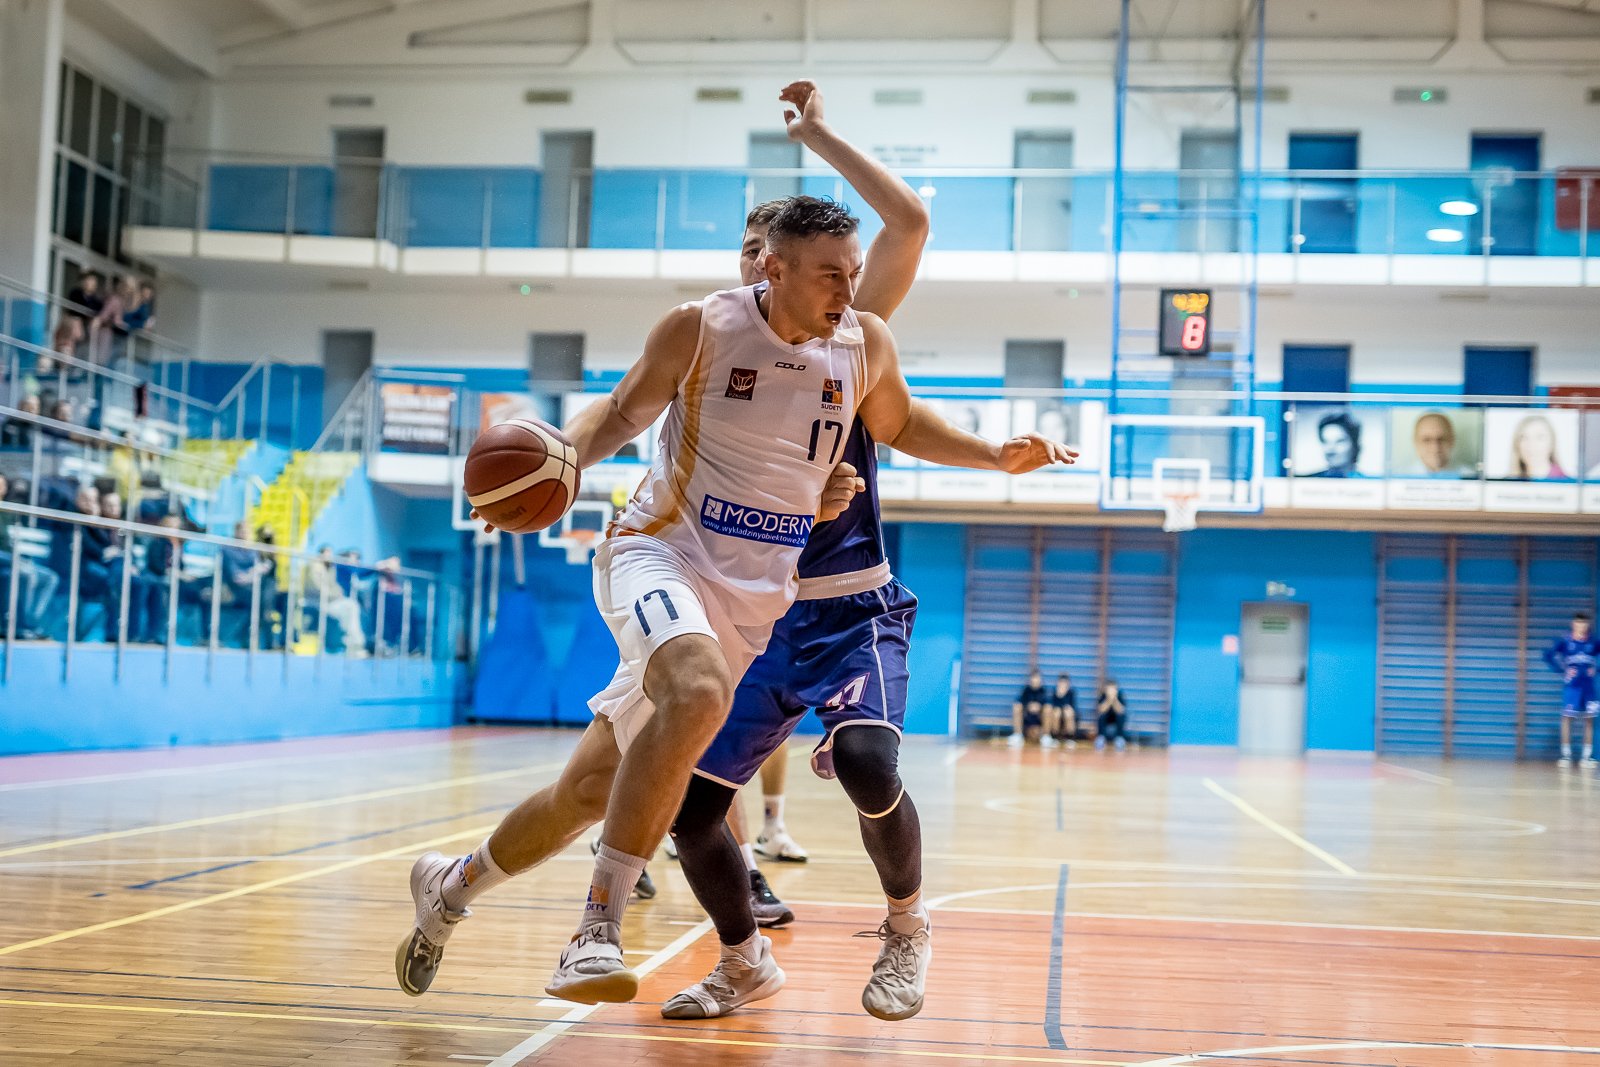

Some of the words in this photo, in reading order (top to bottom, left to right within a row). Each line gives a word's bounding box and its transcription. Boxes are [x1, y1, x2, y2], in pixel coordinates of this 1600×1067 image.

[1182, 315, 1206, 350] 8
[775, 361, 806, 371] COLO
[821, 403, 842, 412] SUDETY
[807, 418, 844, 465] 17
[724, 504, 814, 535] MODERN
[634, 588, 679, 637] 17
